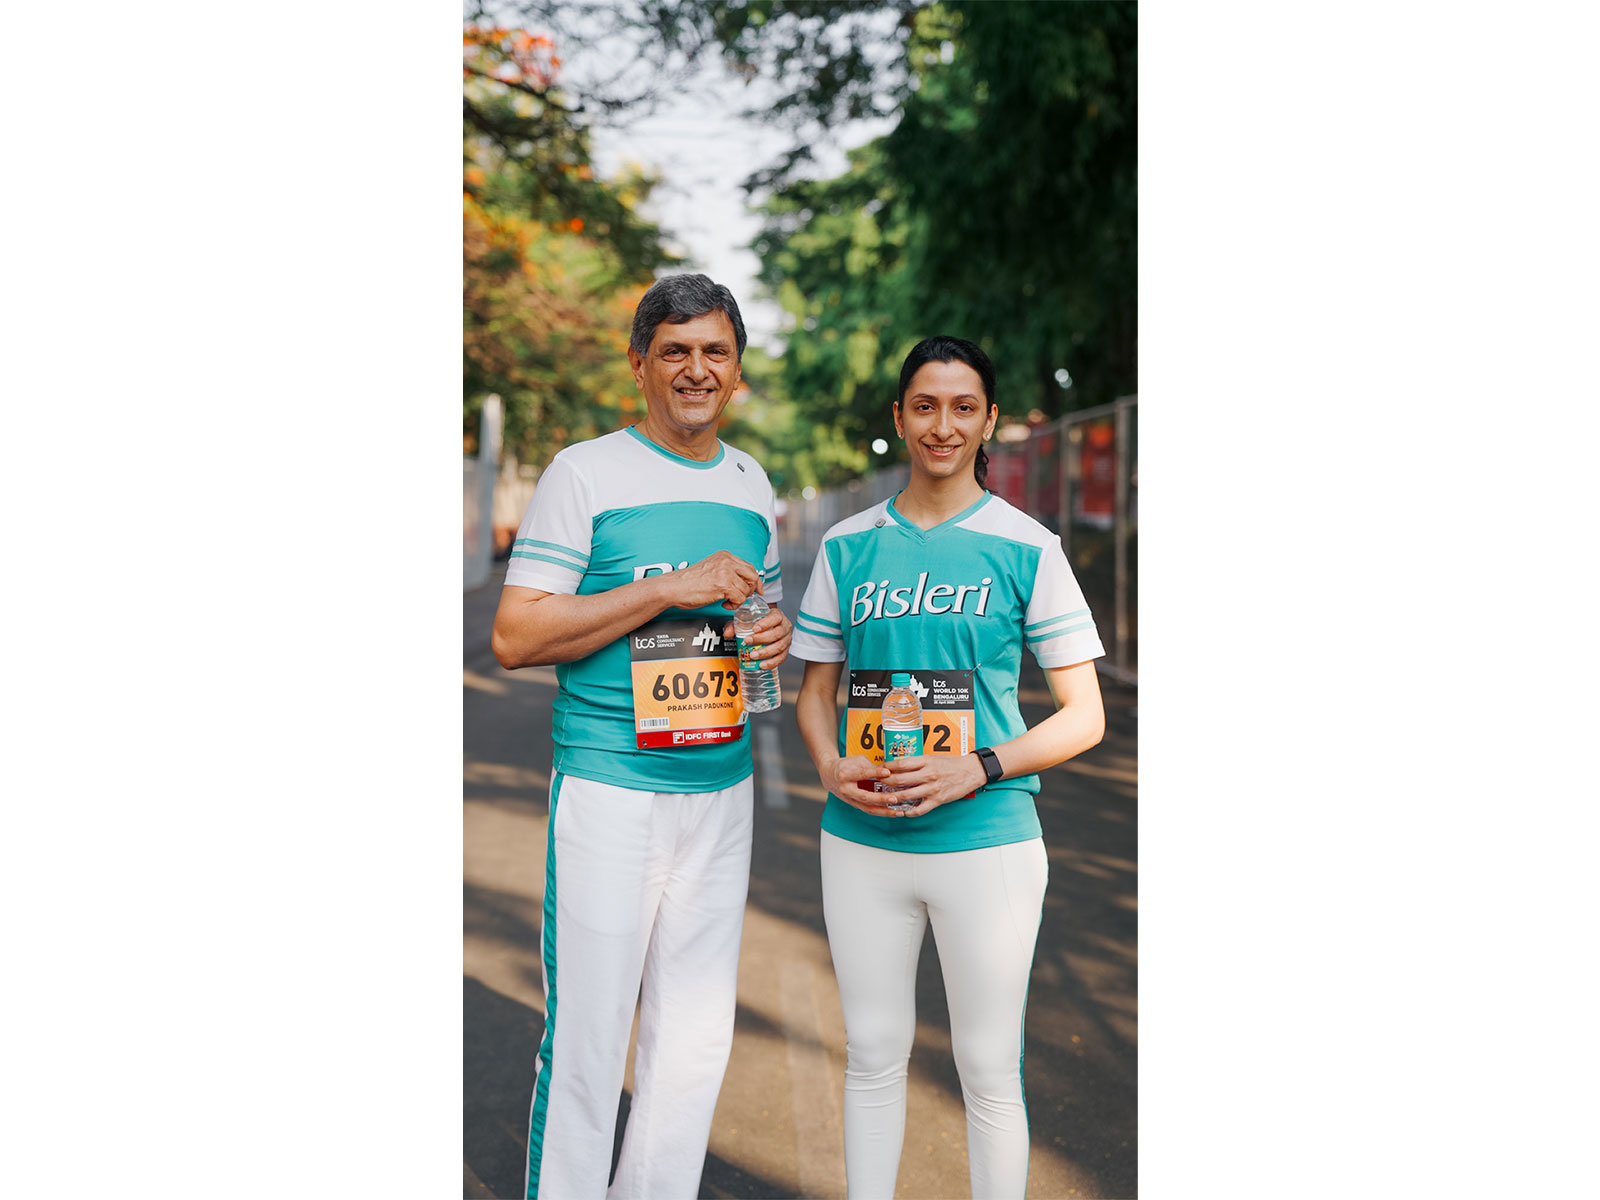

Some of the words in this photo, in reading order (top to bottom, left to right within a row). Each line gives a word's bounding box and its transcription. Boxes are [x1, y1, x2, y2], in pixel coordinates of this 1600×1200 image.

[850, 571, 993, 628] Bisleri
[635, 636, 656, 649] tcs
[652, 671, 739, 702] 60673
[852, 683, 867, 697] tcs
[933, 679, 946, 688] tcs
[667, 704, 704, 712] PRAKASH
[703, 702, 735, 710] PADUKONE
[685, 732, 702, 740] IDFC
[703, 731, 721, 739] FIRST
[860, 723, 951, 752] 6072
